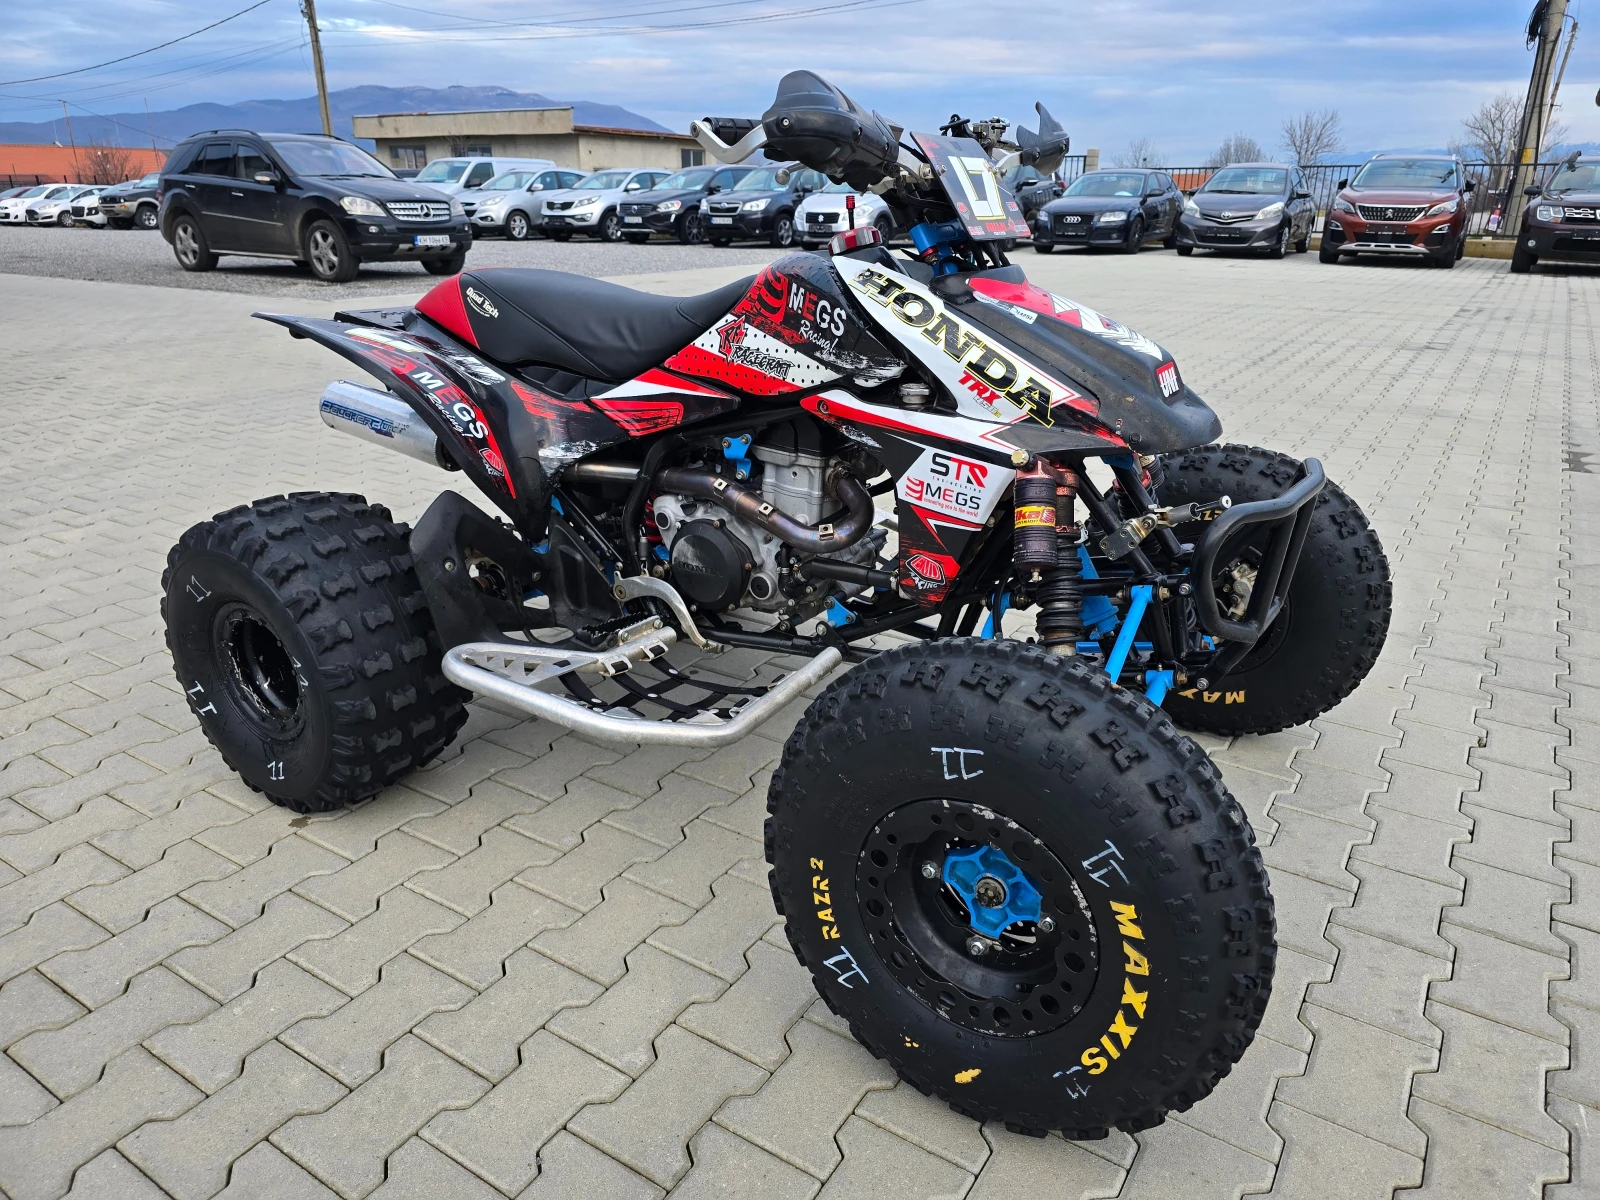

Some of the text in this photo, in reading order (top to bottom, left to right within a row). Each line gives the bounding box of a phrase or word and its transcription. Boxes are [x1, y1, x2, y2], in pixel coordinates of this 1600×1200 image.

[466, 287, 484, 304] Quad
[482, 300, 499, 318] Tech
[788, 282, 847, 337] MEGS
[799, 319, 837, 355] Racing!
[849, 268, 1055, 428] HONDA
[731, 345, 796, 379] RACECRAFT
[412, 371, 489, 439] MEGS
[958, 370, 1003, 406] TRX
[424, 392, 474, 438] Racing!
[930, 452, 989, 489] STR
[925, 482, 982, 510] MEGS
[1080, 900, 1150, 1076] MAXXIS
